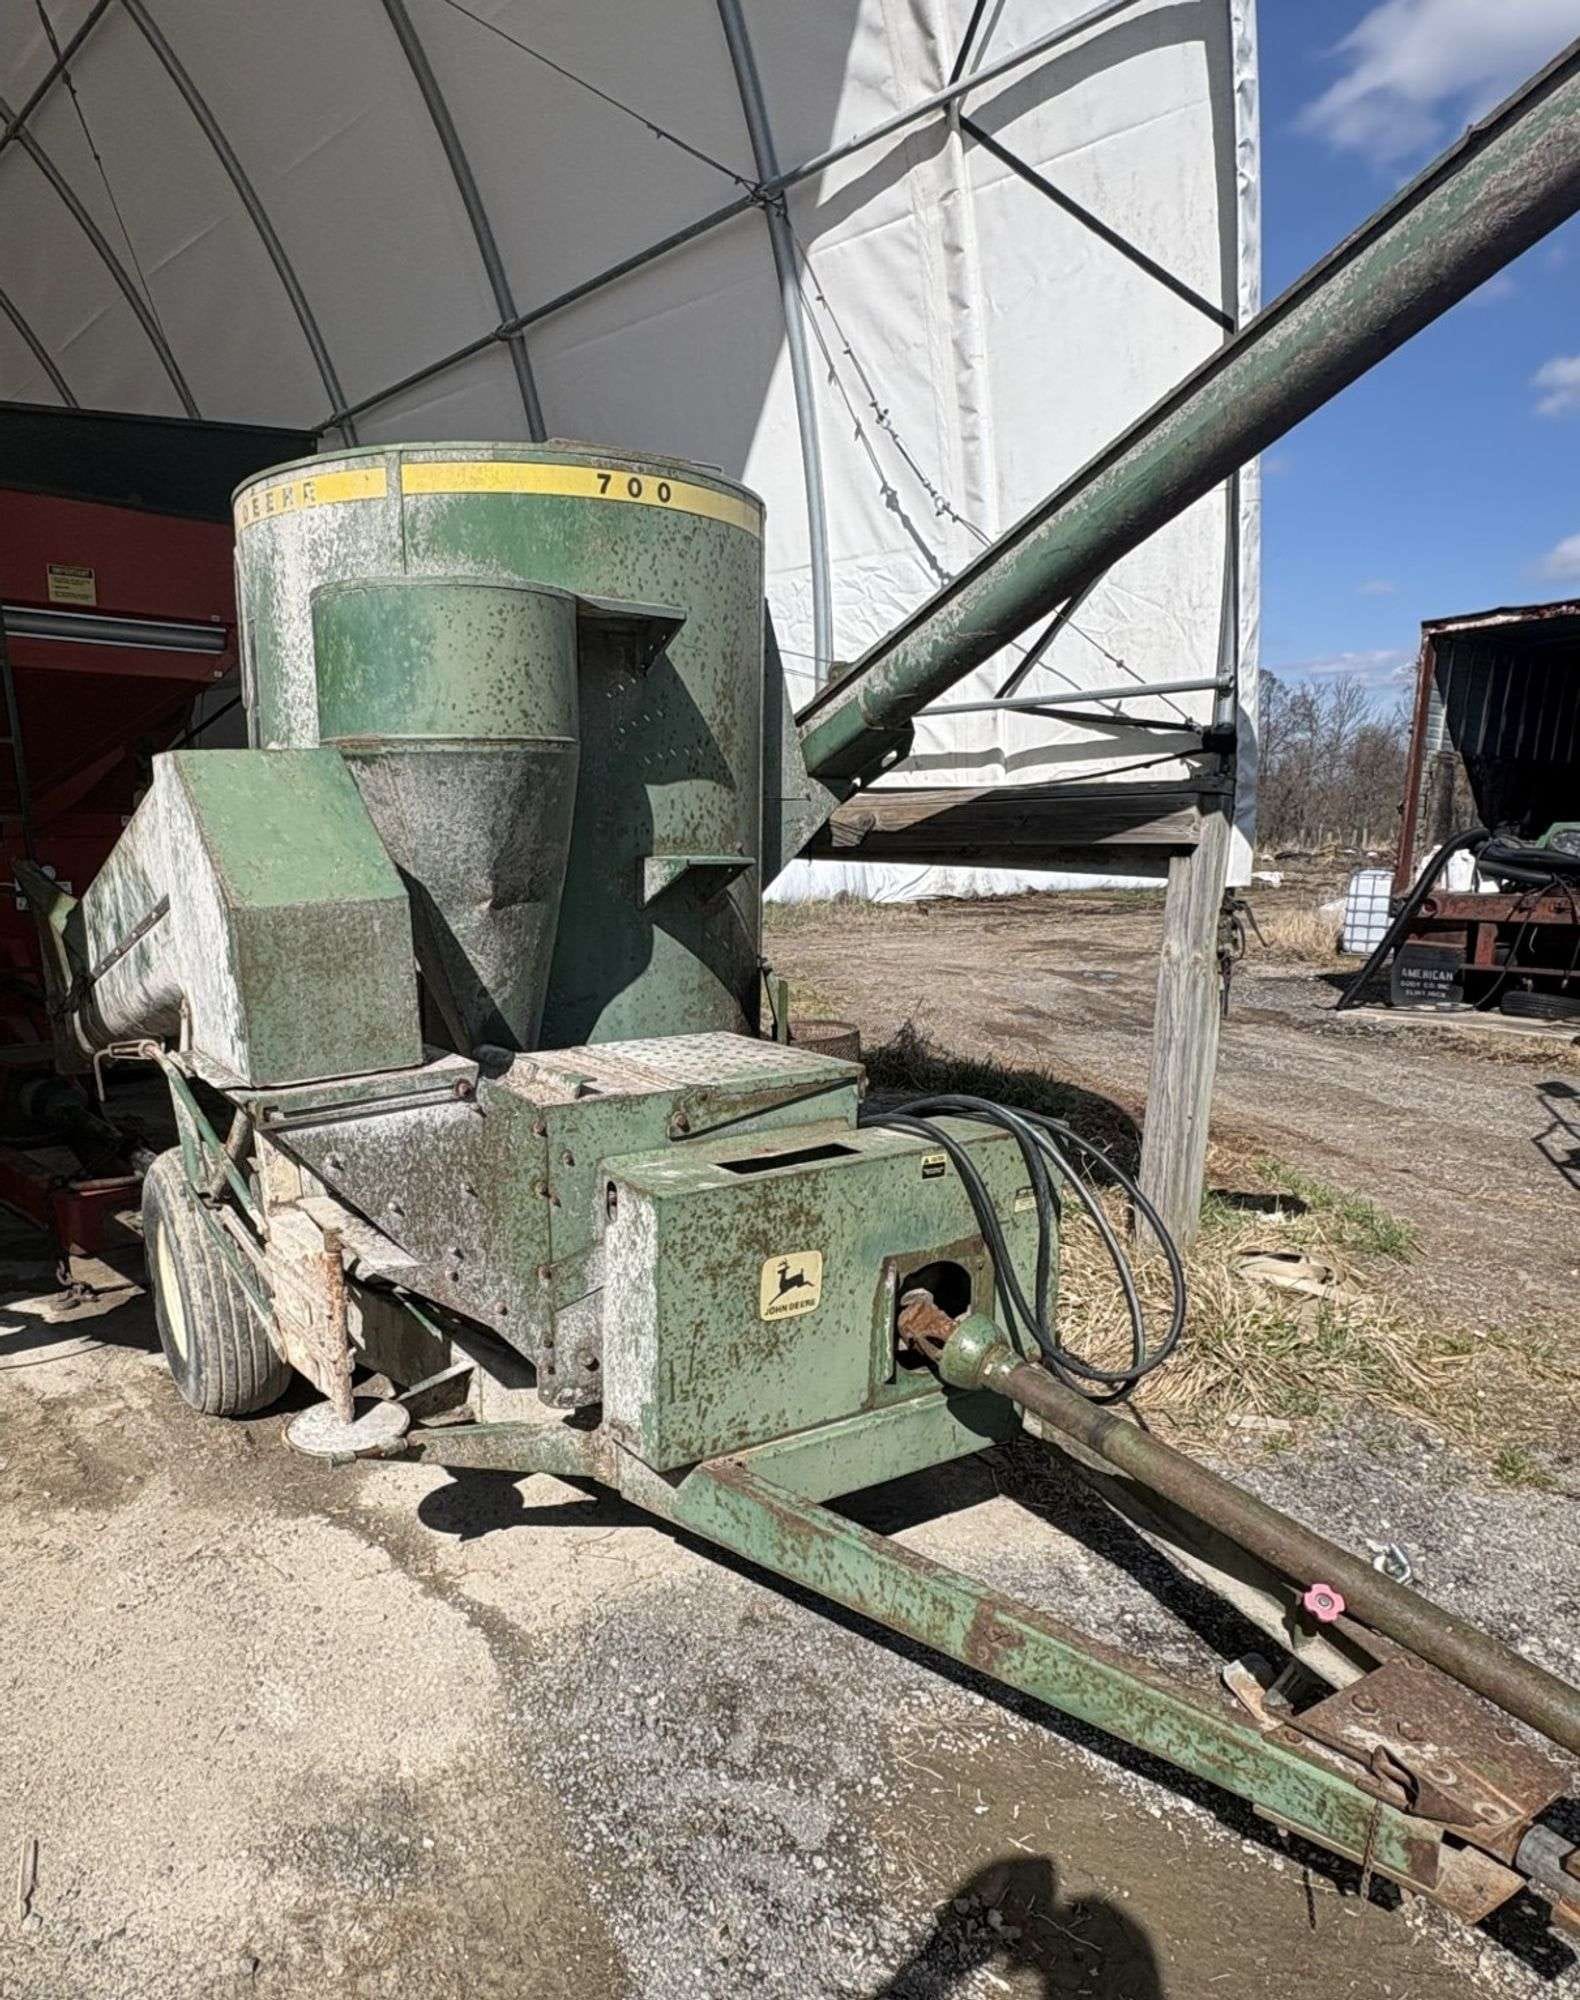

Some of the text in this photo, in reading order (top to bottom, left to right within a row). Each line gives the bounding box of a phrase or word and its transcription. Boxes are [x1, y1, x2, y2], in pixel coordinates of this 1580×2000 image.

[597, 473, 671, 503] 700
[1401, 967, 1453, 981] AMERICAN
[764, 1299, 816, 1316] JOHN DEERE
